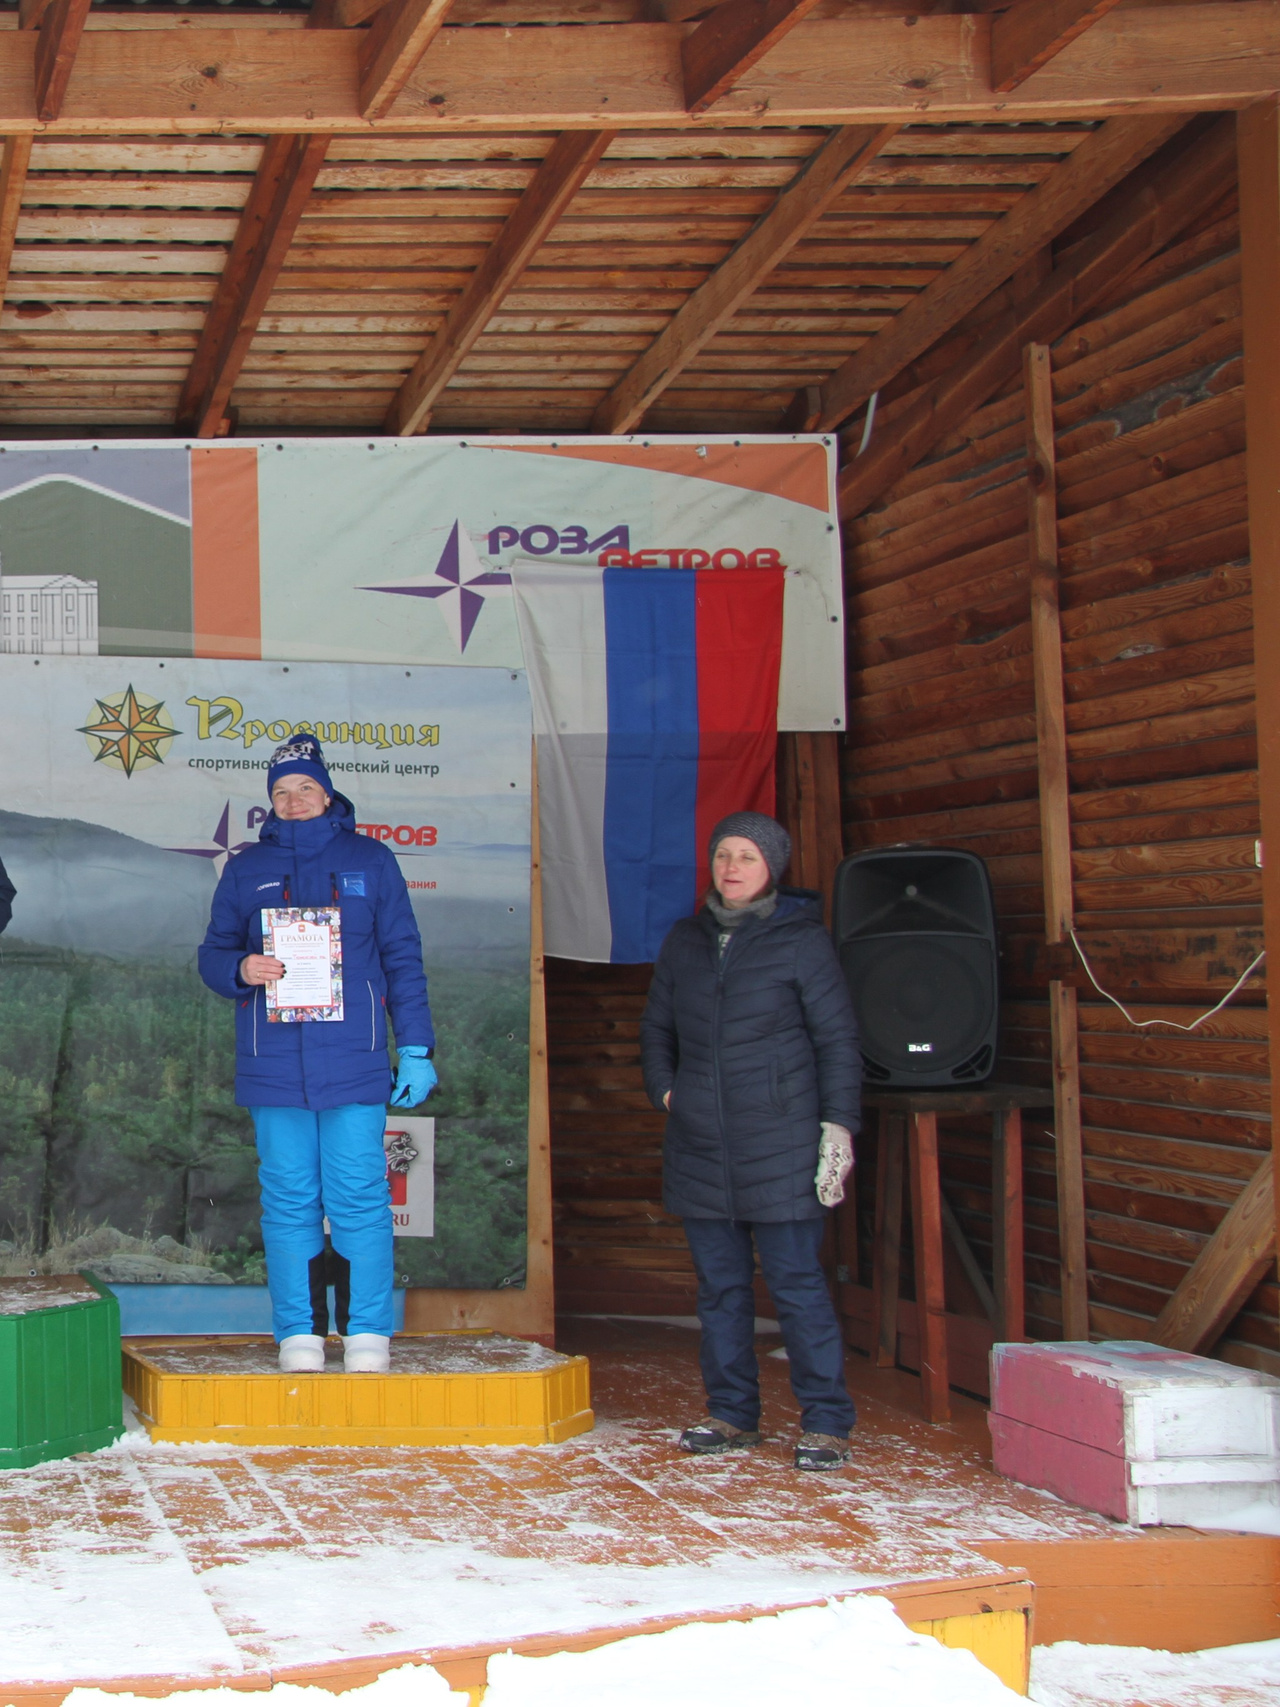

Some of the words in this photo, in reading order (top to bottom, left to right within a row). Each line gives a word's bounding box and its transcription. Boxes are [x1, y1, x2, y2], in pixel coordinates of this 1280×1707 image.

[488, 525, 630, 555] РОЗА
[185, 696, 440, 749] Провинция
[395, 762, 440, 776] центр
[280, 934, 324, 943] ГРАМОТА
